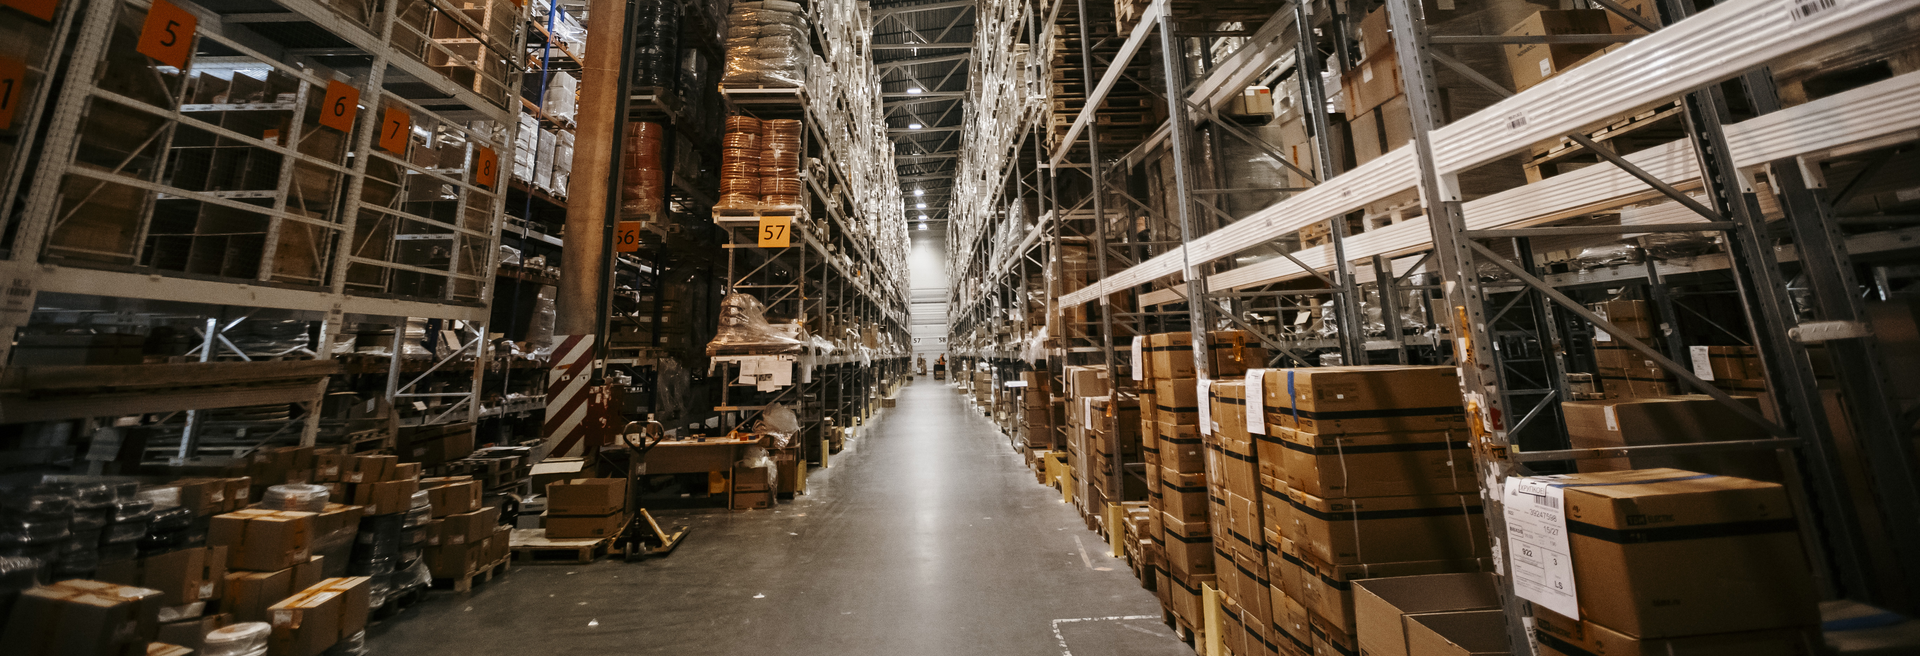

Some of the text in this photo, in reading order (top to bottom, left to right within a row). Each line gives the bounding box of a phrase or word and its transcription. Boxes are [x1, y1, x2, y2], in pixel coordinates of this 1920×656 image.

[160, 20, 180, 47] 5
[334, 96, 347, 117] 6
[390, 120, 400, 139] 7
[483, 160, 491, 176] 8
[763, 224, 786, 240] 57
[1543, 525, 1559, 536] 15/27
[1553, 558, 1558, 566] 3
[1554, 580, 1564, 590] LS
